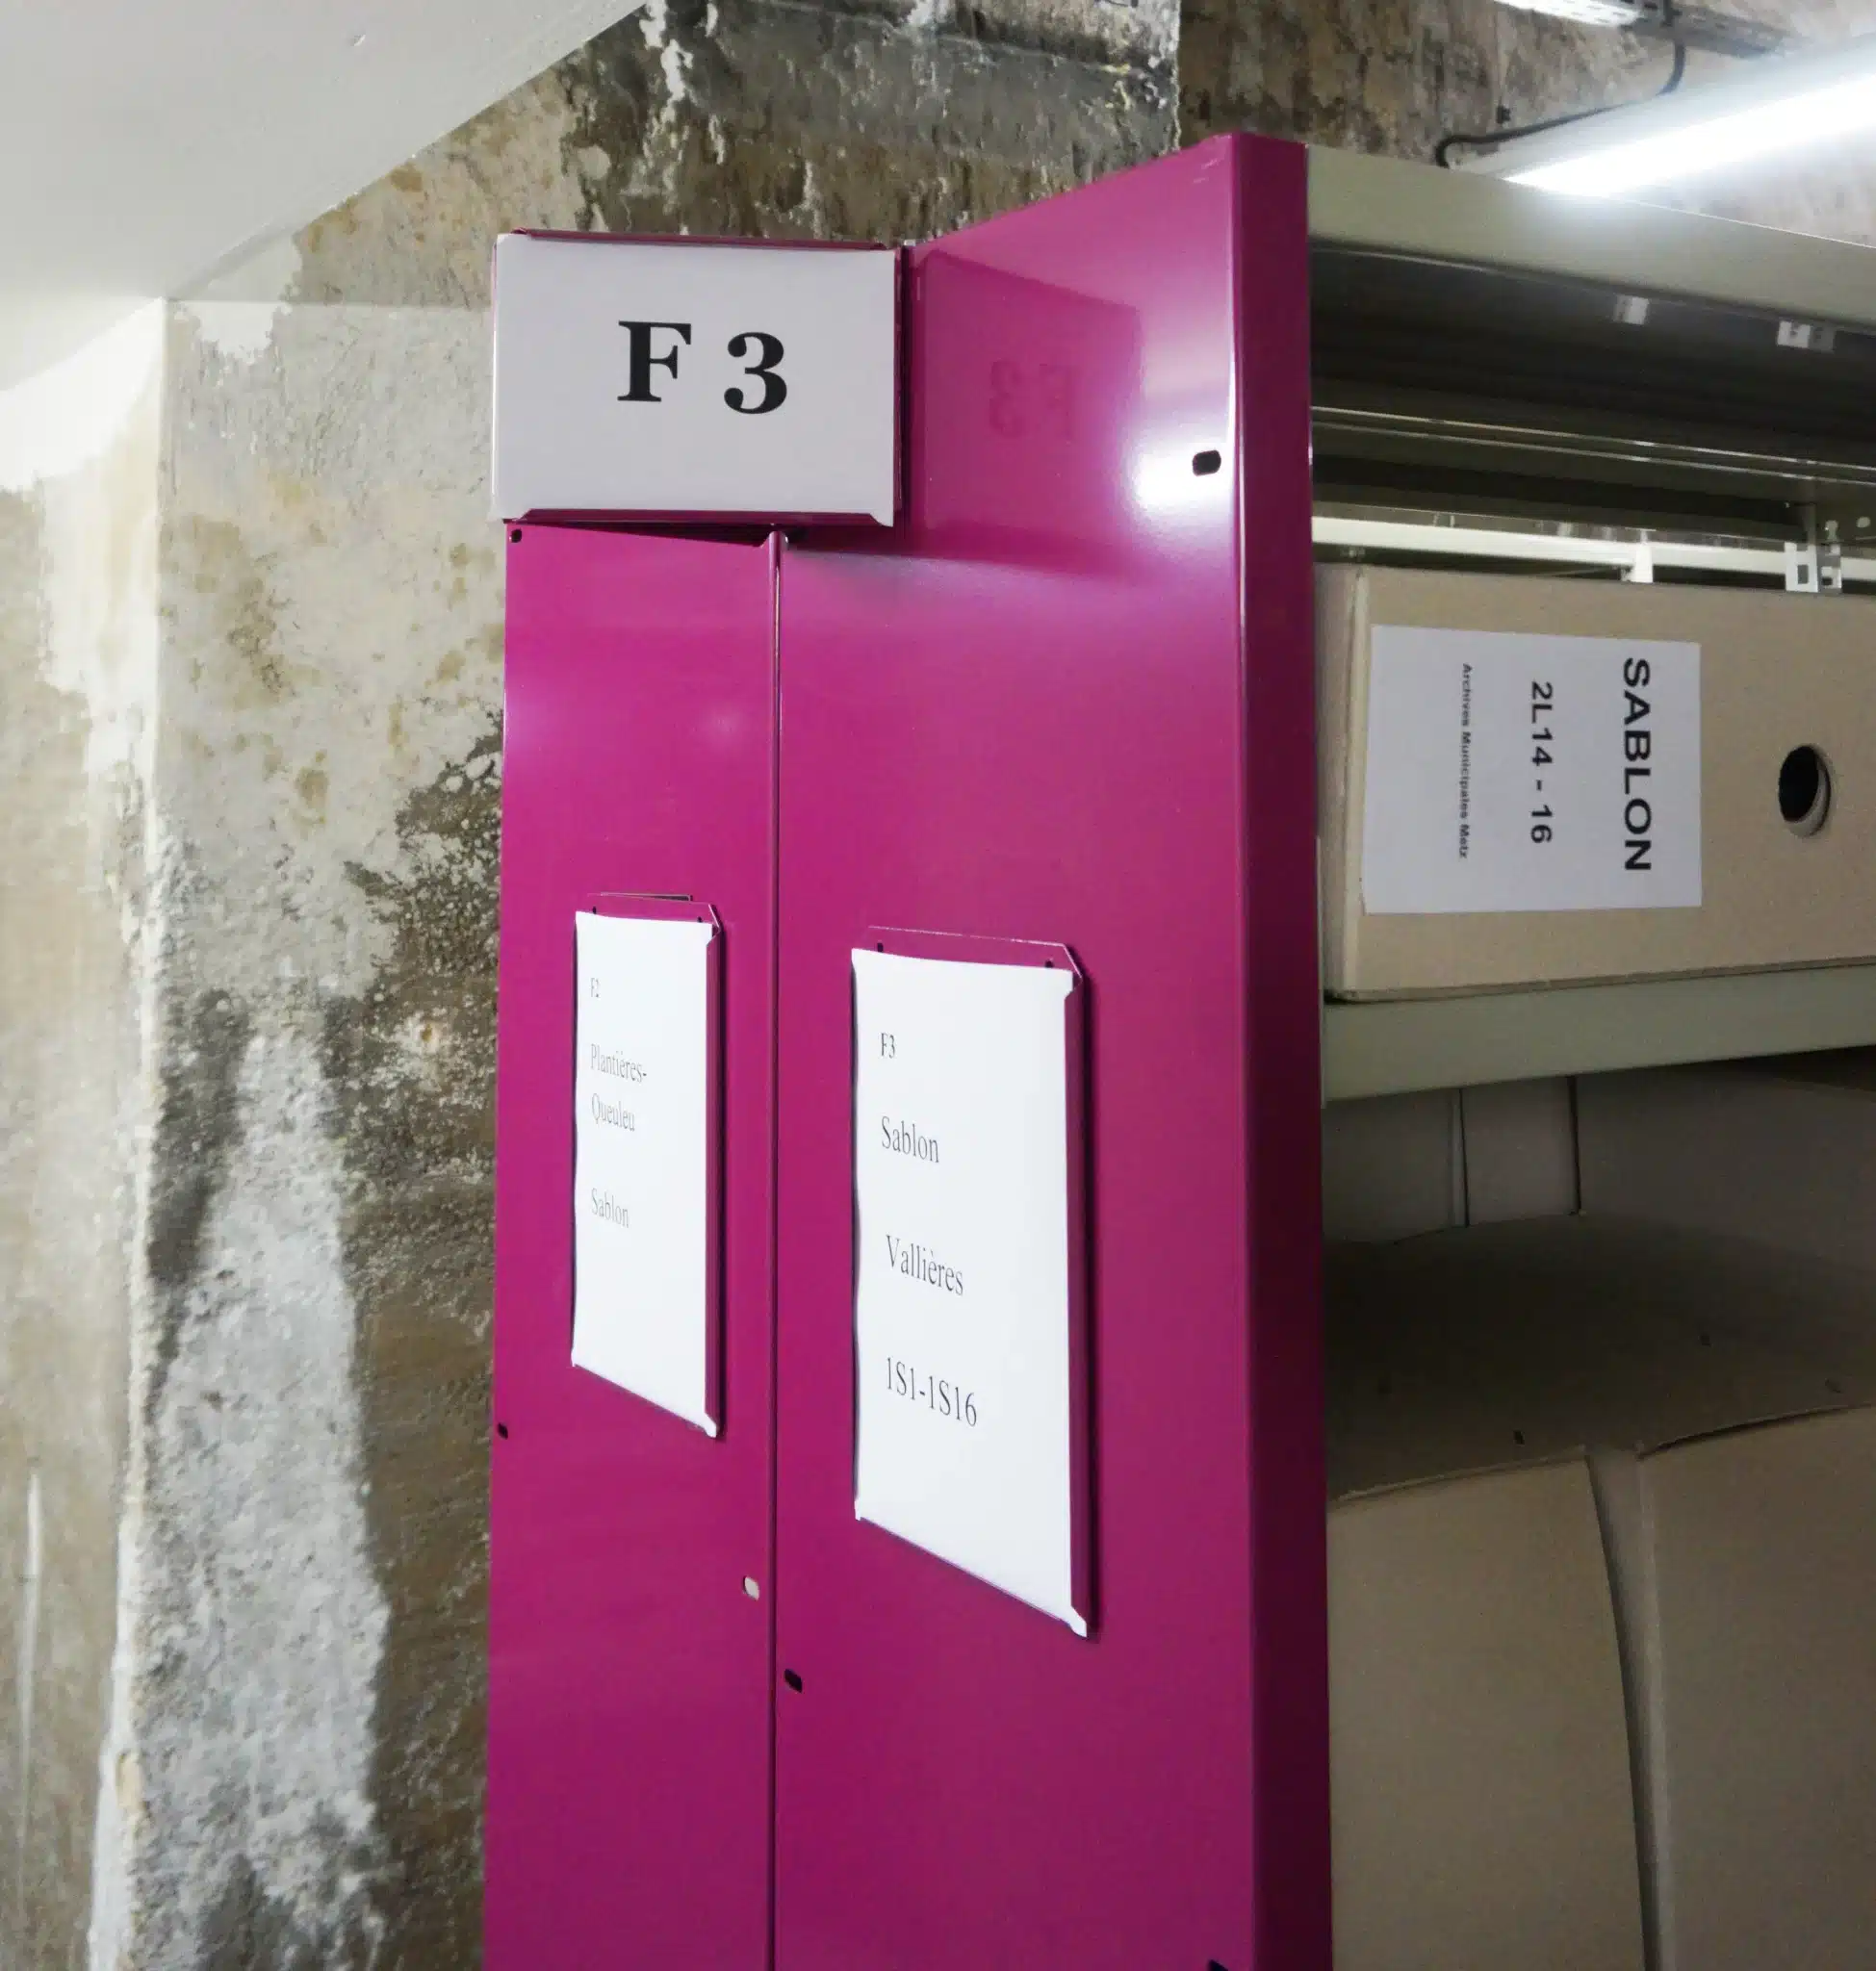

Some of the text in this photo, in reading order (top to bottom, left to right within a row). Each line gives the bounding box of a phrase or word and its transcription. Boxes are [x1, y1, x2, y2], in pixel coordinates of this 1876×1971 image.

[617, 320, 788, 415] F 3
[1530, 680, 1554, 767] 2L14
[1458, 662, 1474, 859] Archives Municipales Metz
[1623, 657, 1653, 871] SABLON
[1529, 804, 1554, 844] 16
[590, 977, 601, 999] F2
[881, 1032, 896, 1060] F3
[591, 1092, 635, 1133] Queuleu
[881, 1115, 940, 1164] Sablon
[591, 1187, 630, 1229] Sablon
[885, 1234, 964, 1296] Vallières
[887, 1356, 978, 1427] 1S1-1S16
